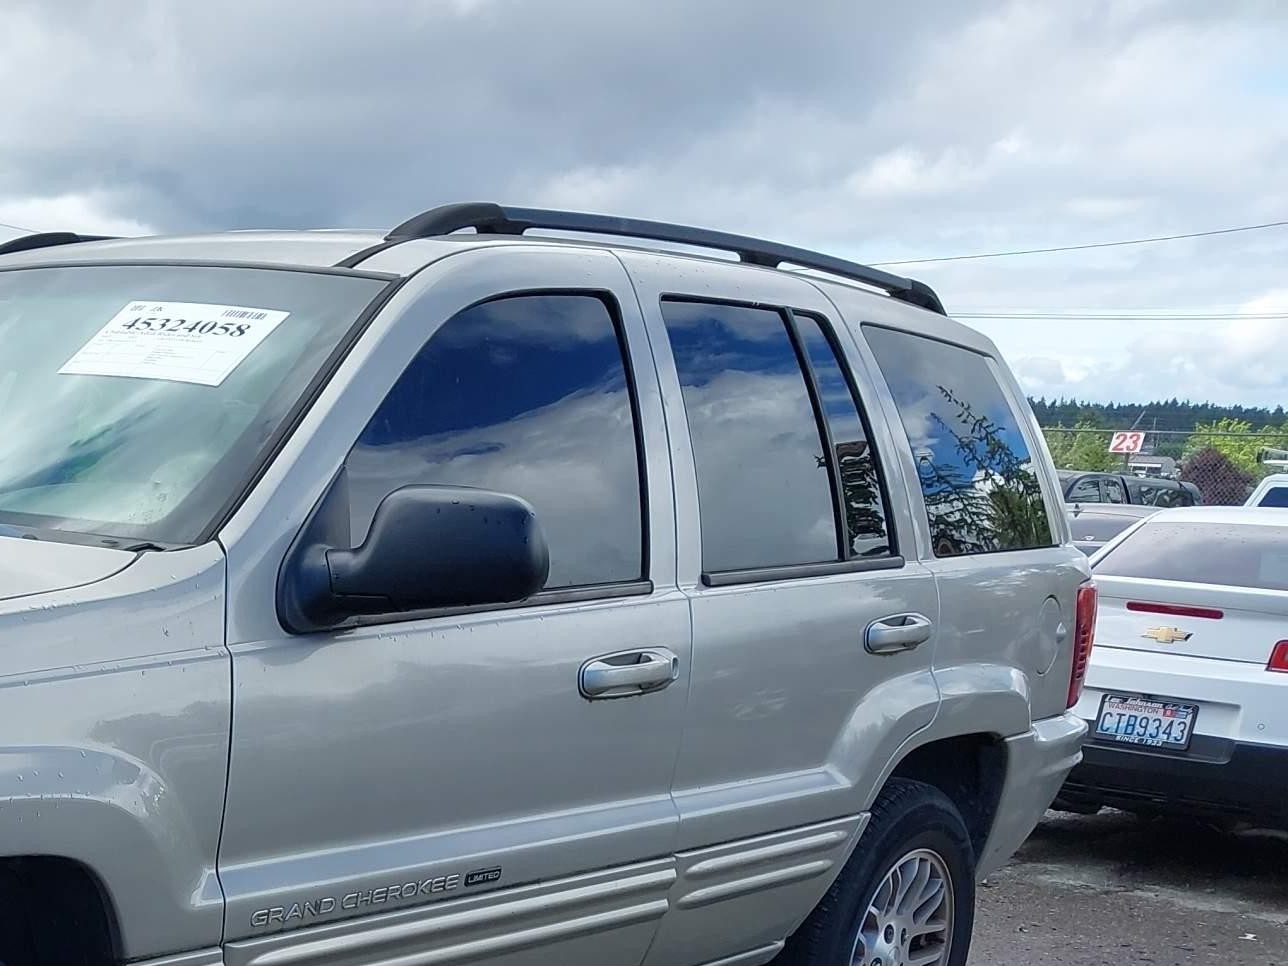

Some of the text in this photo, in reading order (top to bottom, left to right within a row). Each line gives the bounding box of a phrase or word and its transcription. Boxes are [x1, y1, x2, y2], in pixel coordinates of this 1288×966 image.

[122, 317, 252, 338] 45324058
[1112, 433, 1141, 452] 23
[1108, 703, 1158, 715] WASHINGTON
[1100, 712, 1187, 742] CTB9343
[1116, 735, 1140, 744] SINCE
[467, 870, 501, 884] LIMITED
[249, 873, 460, 928] GRAND CHEROKEE
